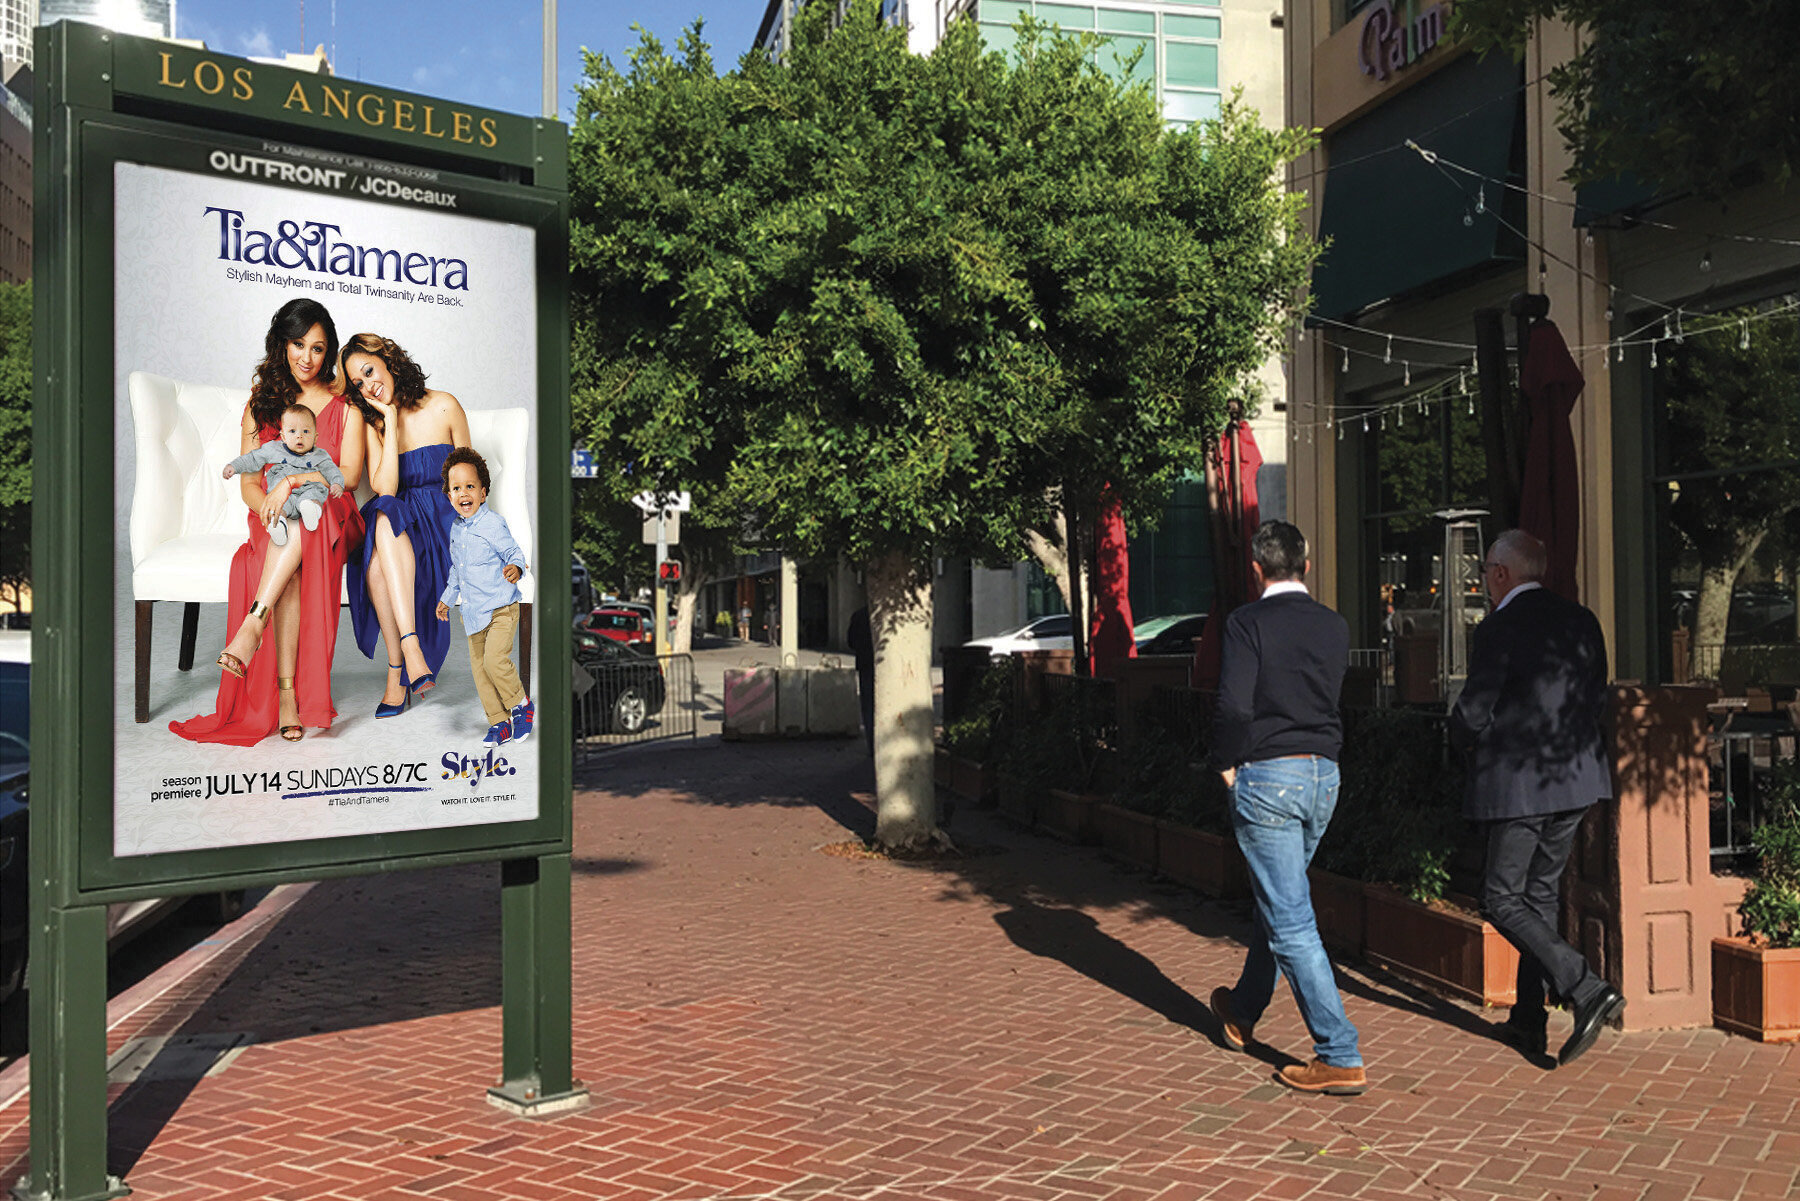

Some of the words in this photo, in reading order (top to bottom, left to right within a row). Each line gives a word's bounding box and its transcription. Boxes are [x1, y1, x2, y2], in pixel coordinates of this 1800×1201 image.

[1358, 0, 1443, 80] Palm
[158, 51, 254, 101] LOS
[283, 80, 497, 148] ANGELES
[209, 150, 347, 190] OUTFRONT
[360, 175, 457, 208] JCDecaux
[203, 206, 469, 291] Tia&Tamera
[226, 267, 263, 284] Stylish
[265, 272, 312, 289] Mayhem
[314, 280, 336, 292] and
[337, 281, 362, 295] Total
[364, 284, 416, 304] Twinsanity
[417, 291, 434, 304] Are
[436, 294, 464, 308] Back.
[162, 776, 202, 788] season
[204, 772, 258, 800] JULY
[260, 771, 282, 793] 14
[287, 765, 379, 791] SUNDAYS
[382, 762, 428, 785] 8/7C
[441, 748, 517, 787] Style.
[150, 787, 202, 802] premiere
[328, 795, 390, 806] #TiaAndTamera
[440, 798, 460, 806] WATCH
[470, 796, 484, 804] LOVE
[493, 794, 509, 803] STYLE
